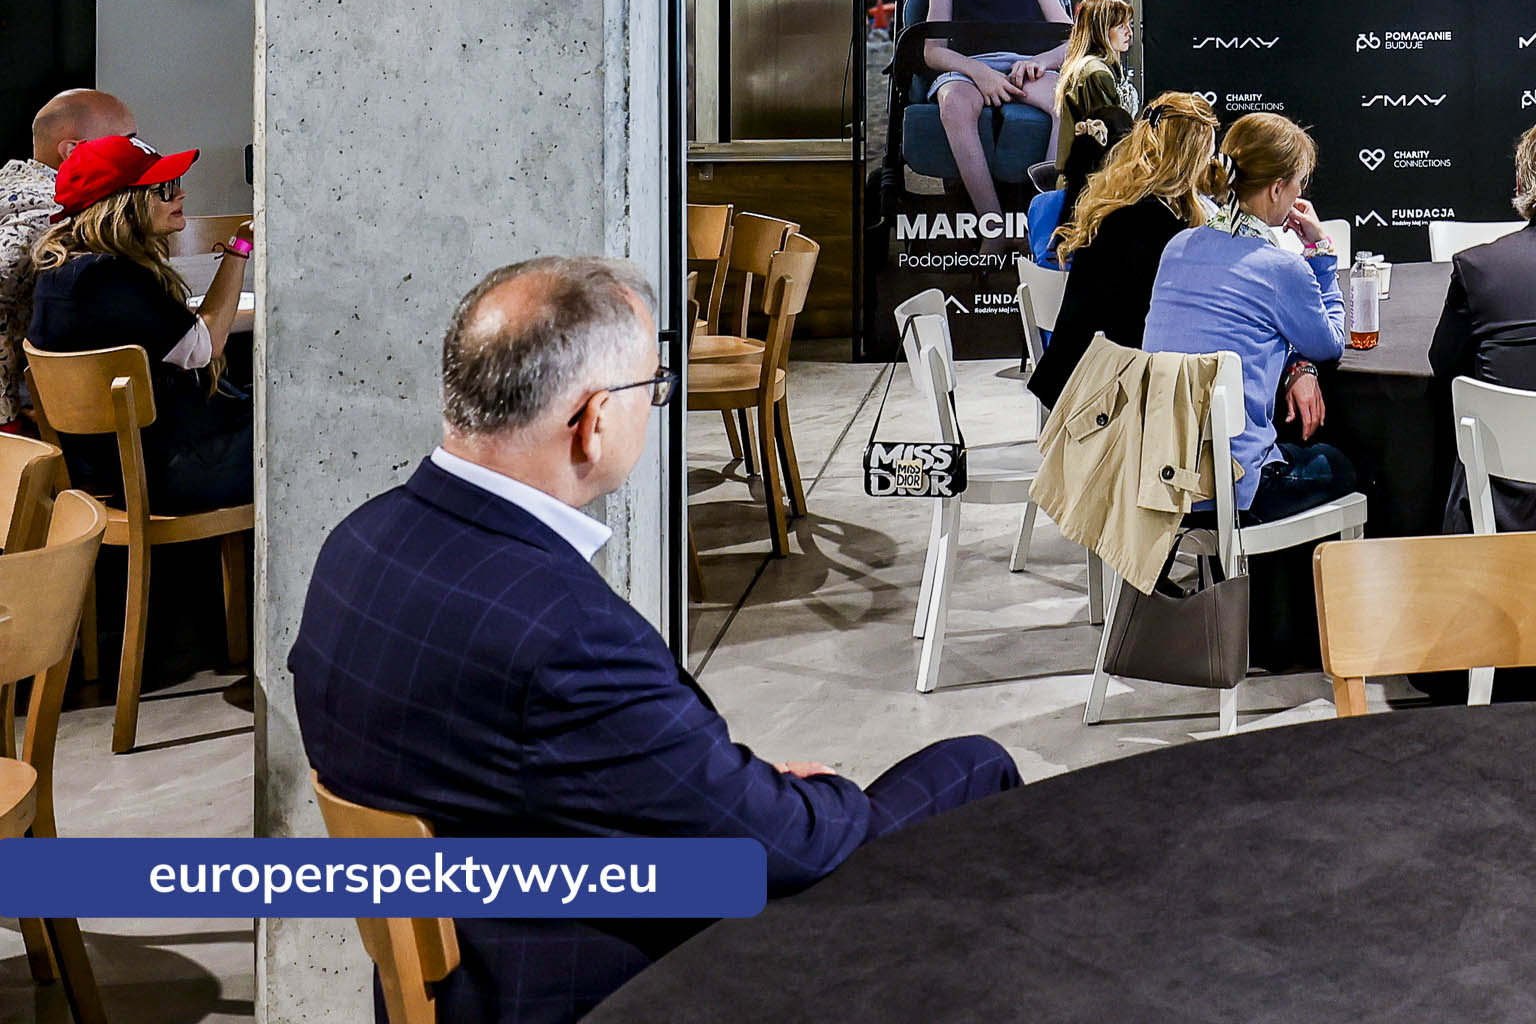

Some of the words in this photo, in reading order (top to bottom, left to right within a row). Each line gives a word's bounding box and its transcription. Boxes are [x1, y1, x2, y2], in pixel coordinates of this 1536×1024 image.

[1385, 32, 1452, 41] POMAGANIE
[1385, 41, 1424, 50] BUDUJE
[1226, 93, 1262, 102] CHARITY
[1226, 102, 1284, 111] CONNECTIONS
[1394, 150, 1430, 159] CHARITY
[1394, 159, 1451, 168] CONNECTIONS
[1391, 208, 1455, 219] FUNDACJA
[899, 252, 1007, 270] Podopieczny
[975, 294, 1020, 305] FUNDA
[975, 307, 998, 315] Rodziny
[999, 307, 1010, 315] Maj
[897, 465, 921, 474] MISS
[897, 474, 920, 487] DIOR
